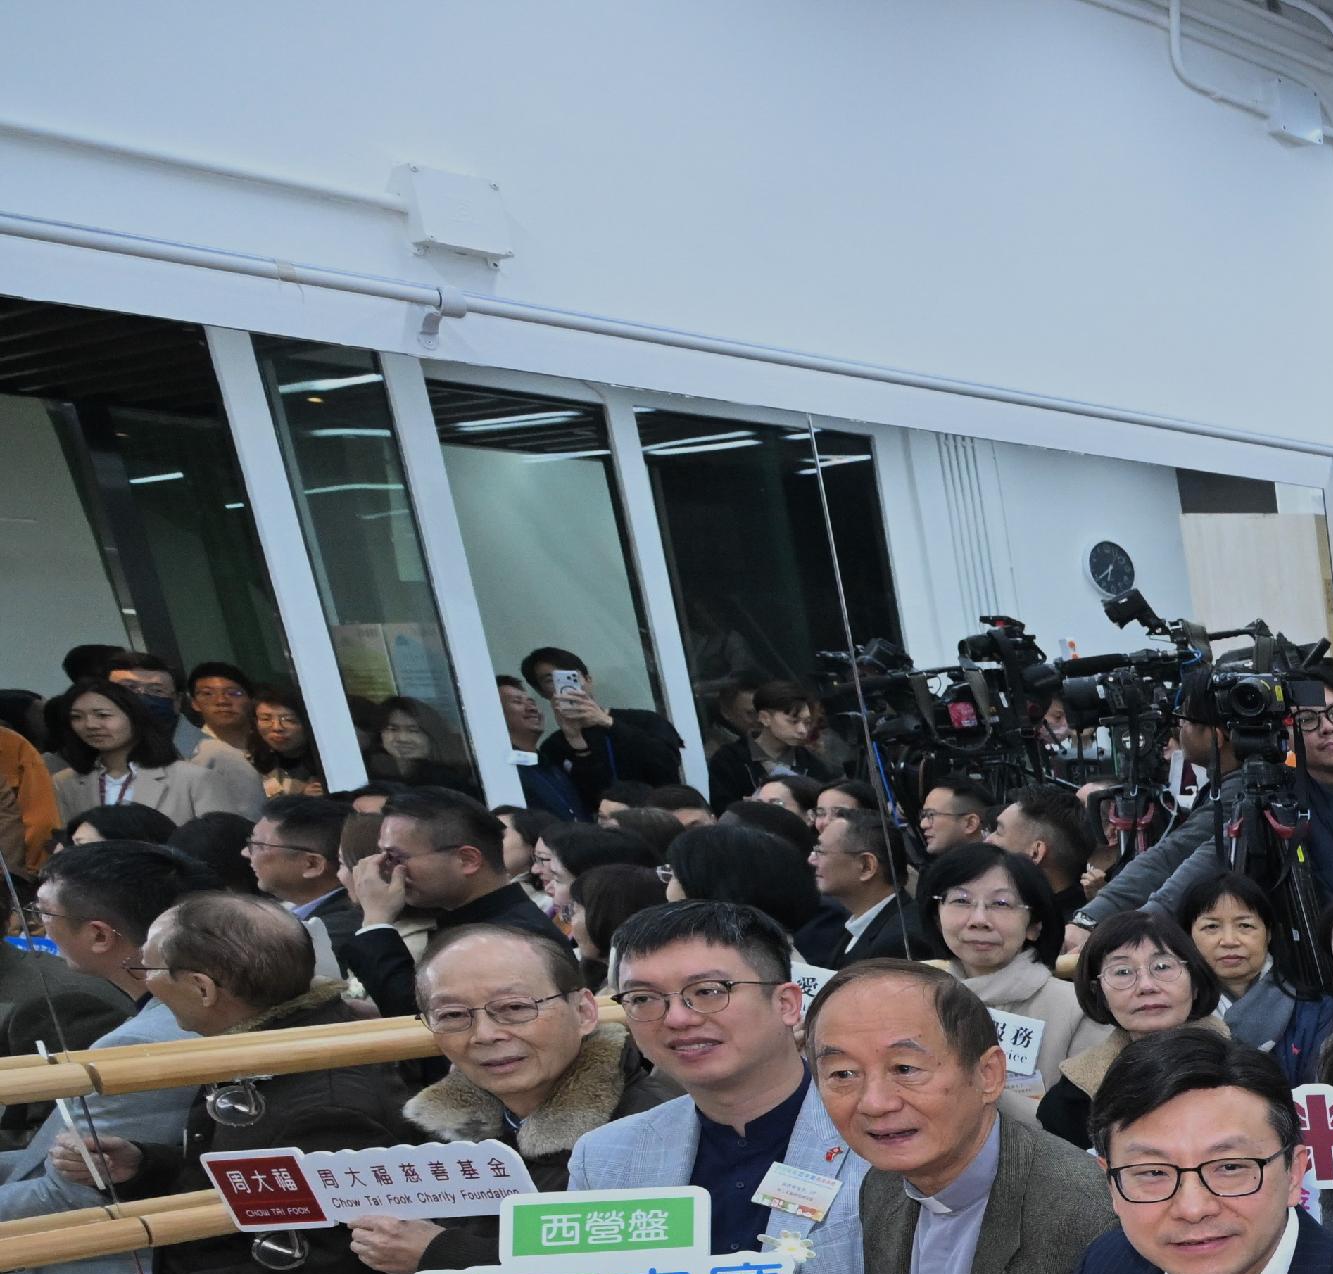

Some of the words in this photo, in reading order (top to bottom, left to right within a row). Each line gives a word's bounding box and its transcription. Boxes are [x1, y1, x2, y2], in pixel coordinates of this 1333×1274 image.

[226, 1168, 298, 1194] 周大福
[316, 1158, 511, 1189] 周大福慈善基金
[246, 1208, 269, 1218] CHOW
[271, 1207, 286, 1217] TAI
[287, 1206, 311, 1216] FOOK
[332, 1196, 361, 1209] Chow
[364, 1195, 383, 1208] Tai
[387, 1193, 411, 1205] Fook
[417, 1190, 456, 1205] Charity
[540, 1208, 670, 1247] 西營盤
